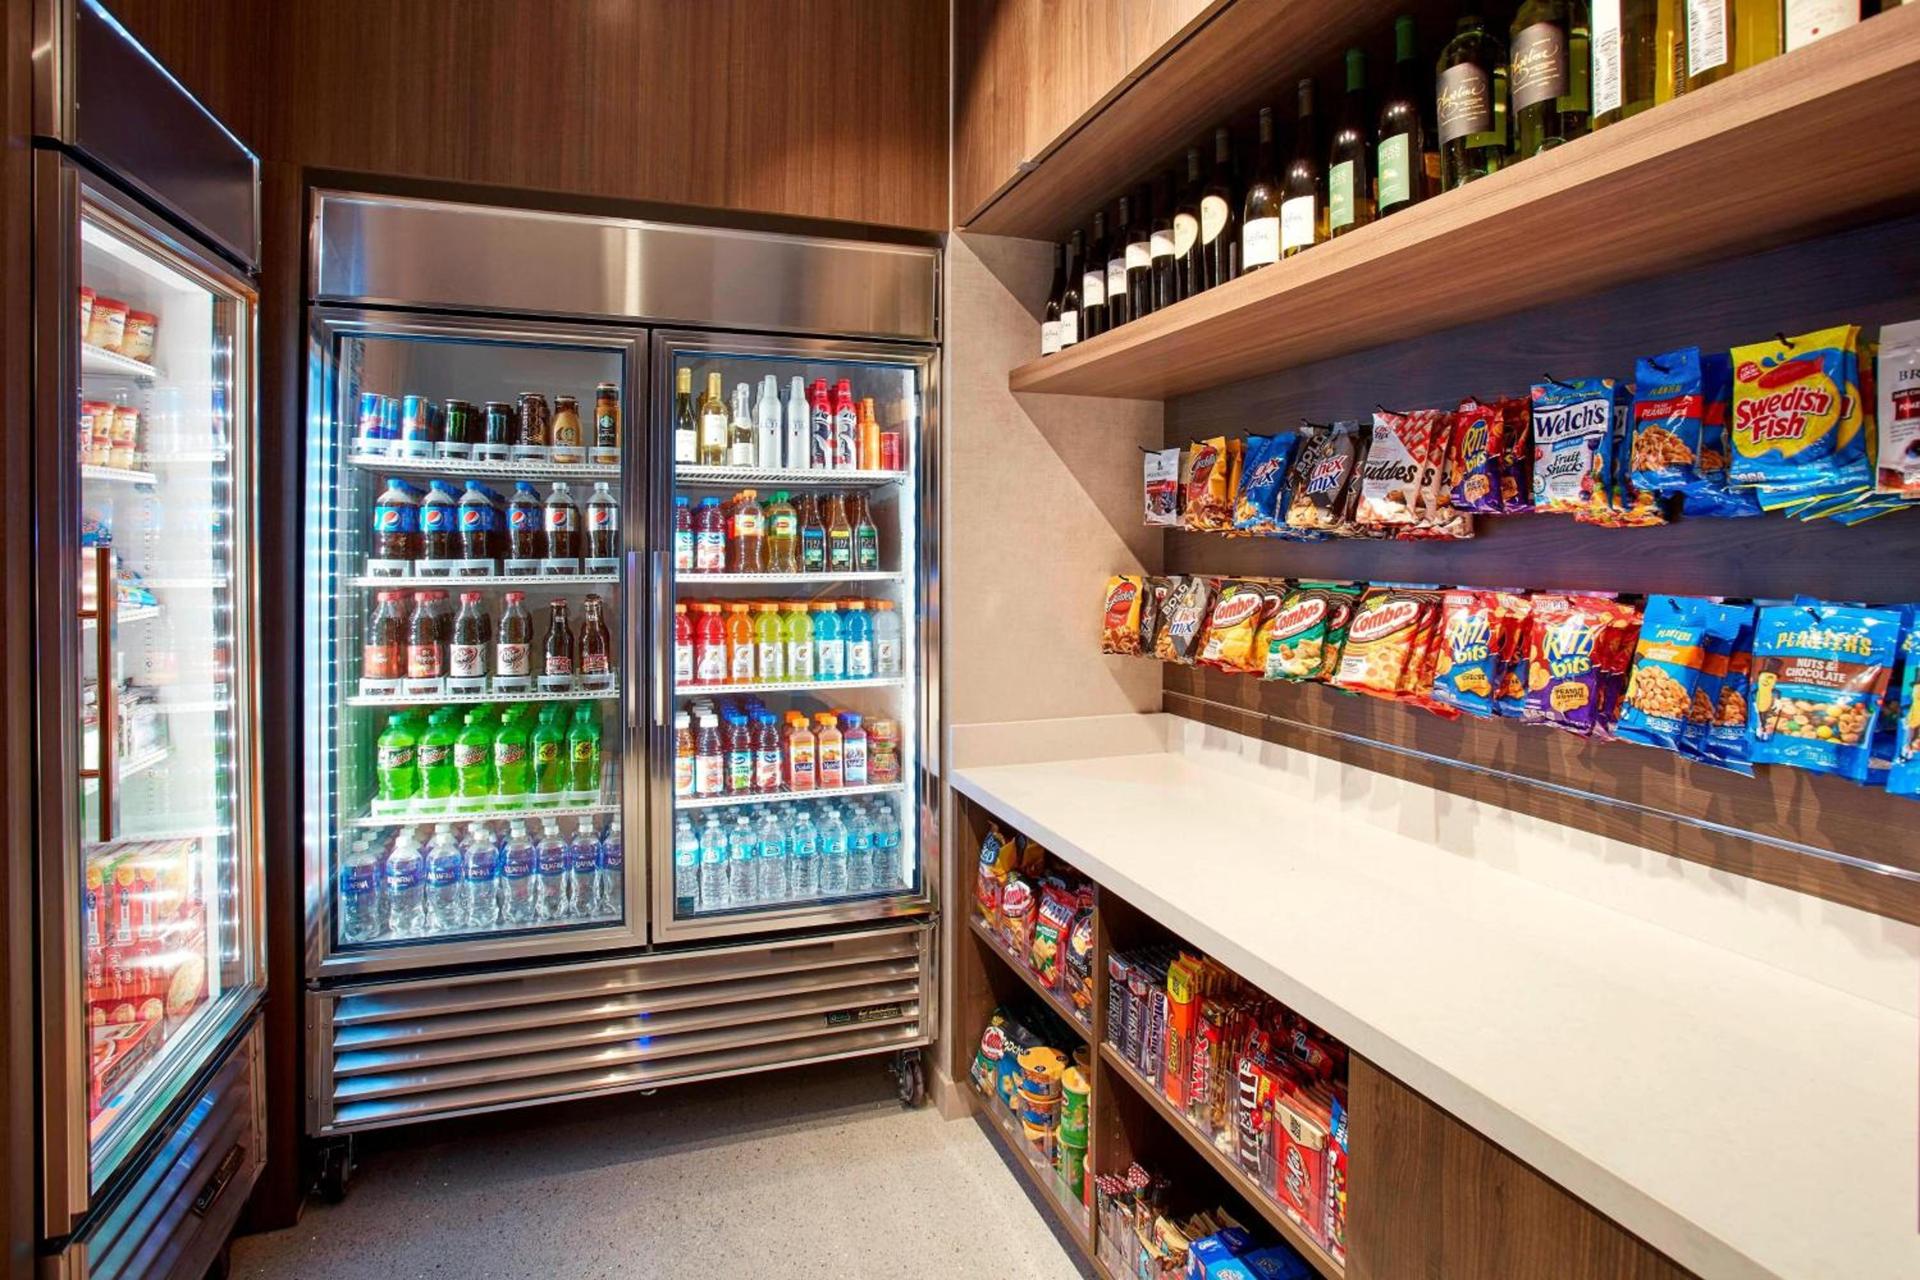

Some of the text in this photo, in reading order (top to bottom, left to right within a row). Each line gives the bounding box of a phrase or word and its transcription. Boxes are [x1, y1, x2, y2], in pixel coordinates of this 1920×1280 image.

[1735, 385, 1831, 430] Swedish
[1534, 404, 1605, 438] Welch's
[1750, 411, 1807, 443] Fish
[1545, 461, 1584, 476] Snacks
[1554, 450, 1581, 467] Fruit
[1365, 461, 1418, 483] uddies
[1162, 583, 1189, 615] BOLD
[1215, 597, 1256, 620] Combos
[1276, 602, 1321, 628] Combos
[1352, 602, 1413, 633] Combos
[1453, 645, 1488, 664] bits
[1545, 625, 1595, 661] RITZ
[1776, 629, 1872, 656] PLANTERS
[1551, 657, 1591, 678] bits
[1785, 667, 1848, 683] CHOCOLATE
[1796, 658, 1824, 670] NUTS
